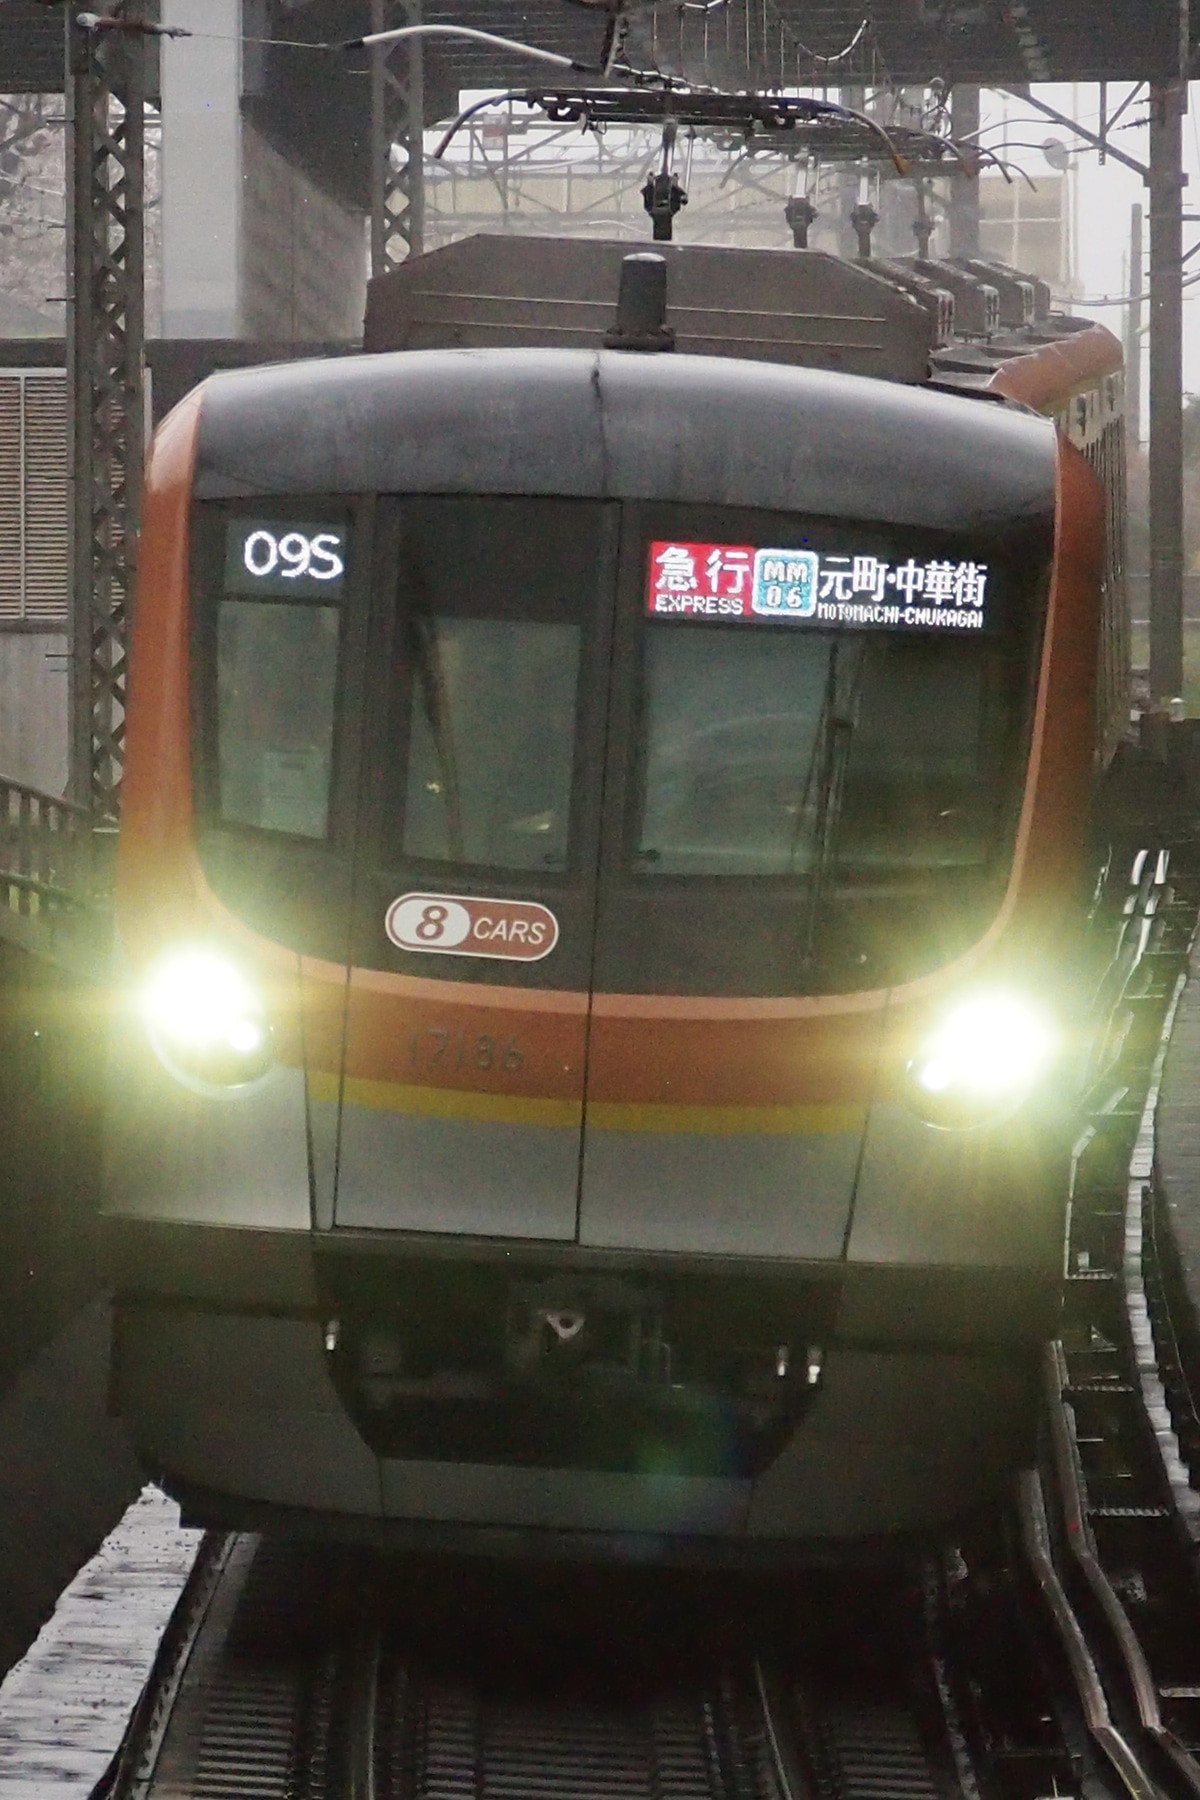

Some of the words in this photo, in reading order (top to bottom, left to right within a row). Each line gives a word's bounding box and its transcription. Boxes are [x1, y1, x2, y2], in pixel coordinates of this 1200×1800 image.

[244, 530, 344, 580] 09S
[655, 546, 750, 594] 急行
[763, 560, 808, 583] MM
[655, 593, 744, 615] EXPRESS
[766, 586, 803, 609] 06
[415, 905, 449, 941] 8
[473, 917, 547, 945] CARS
